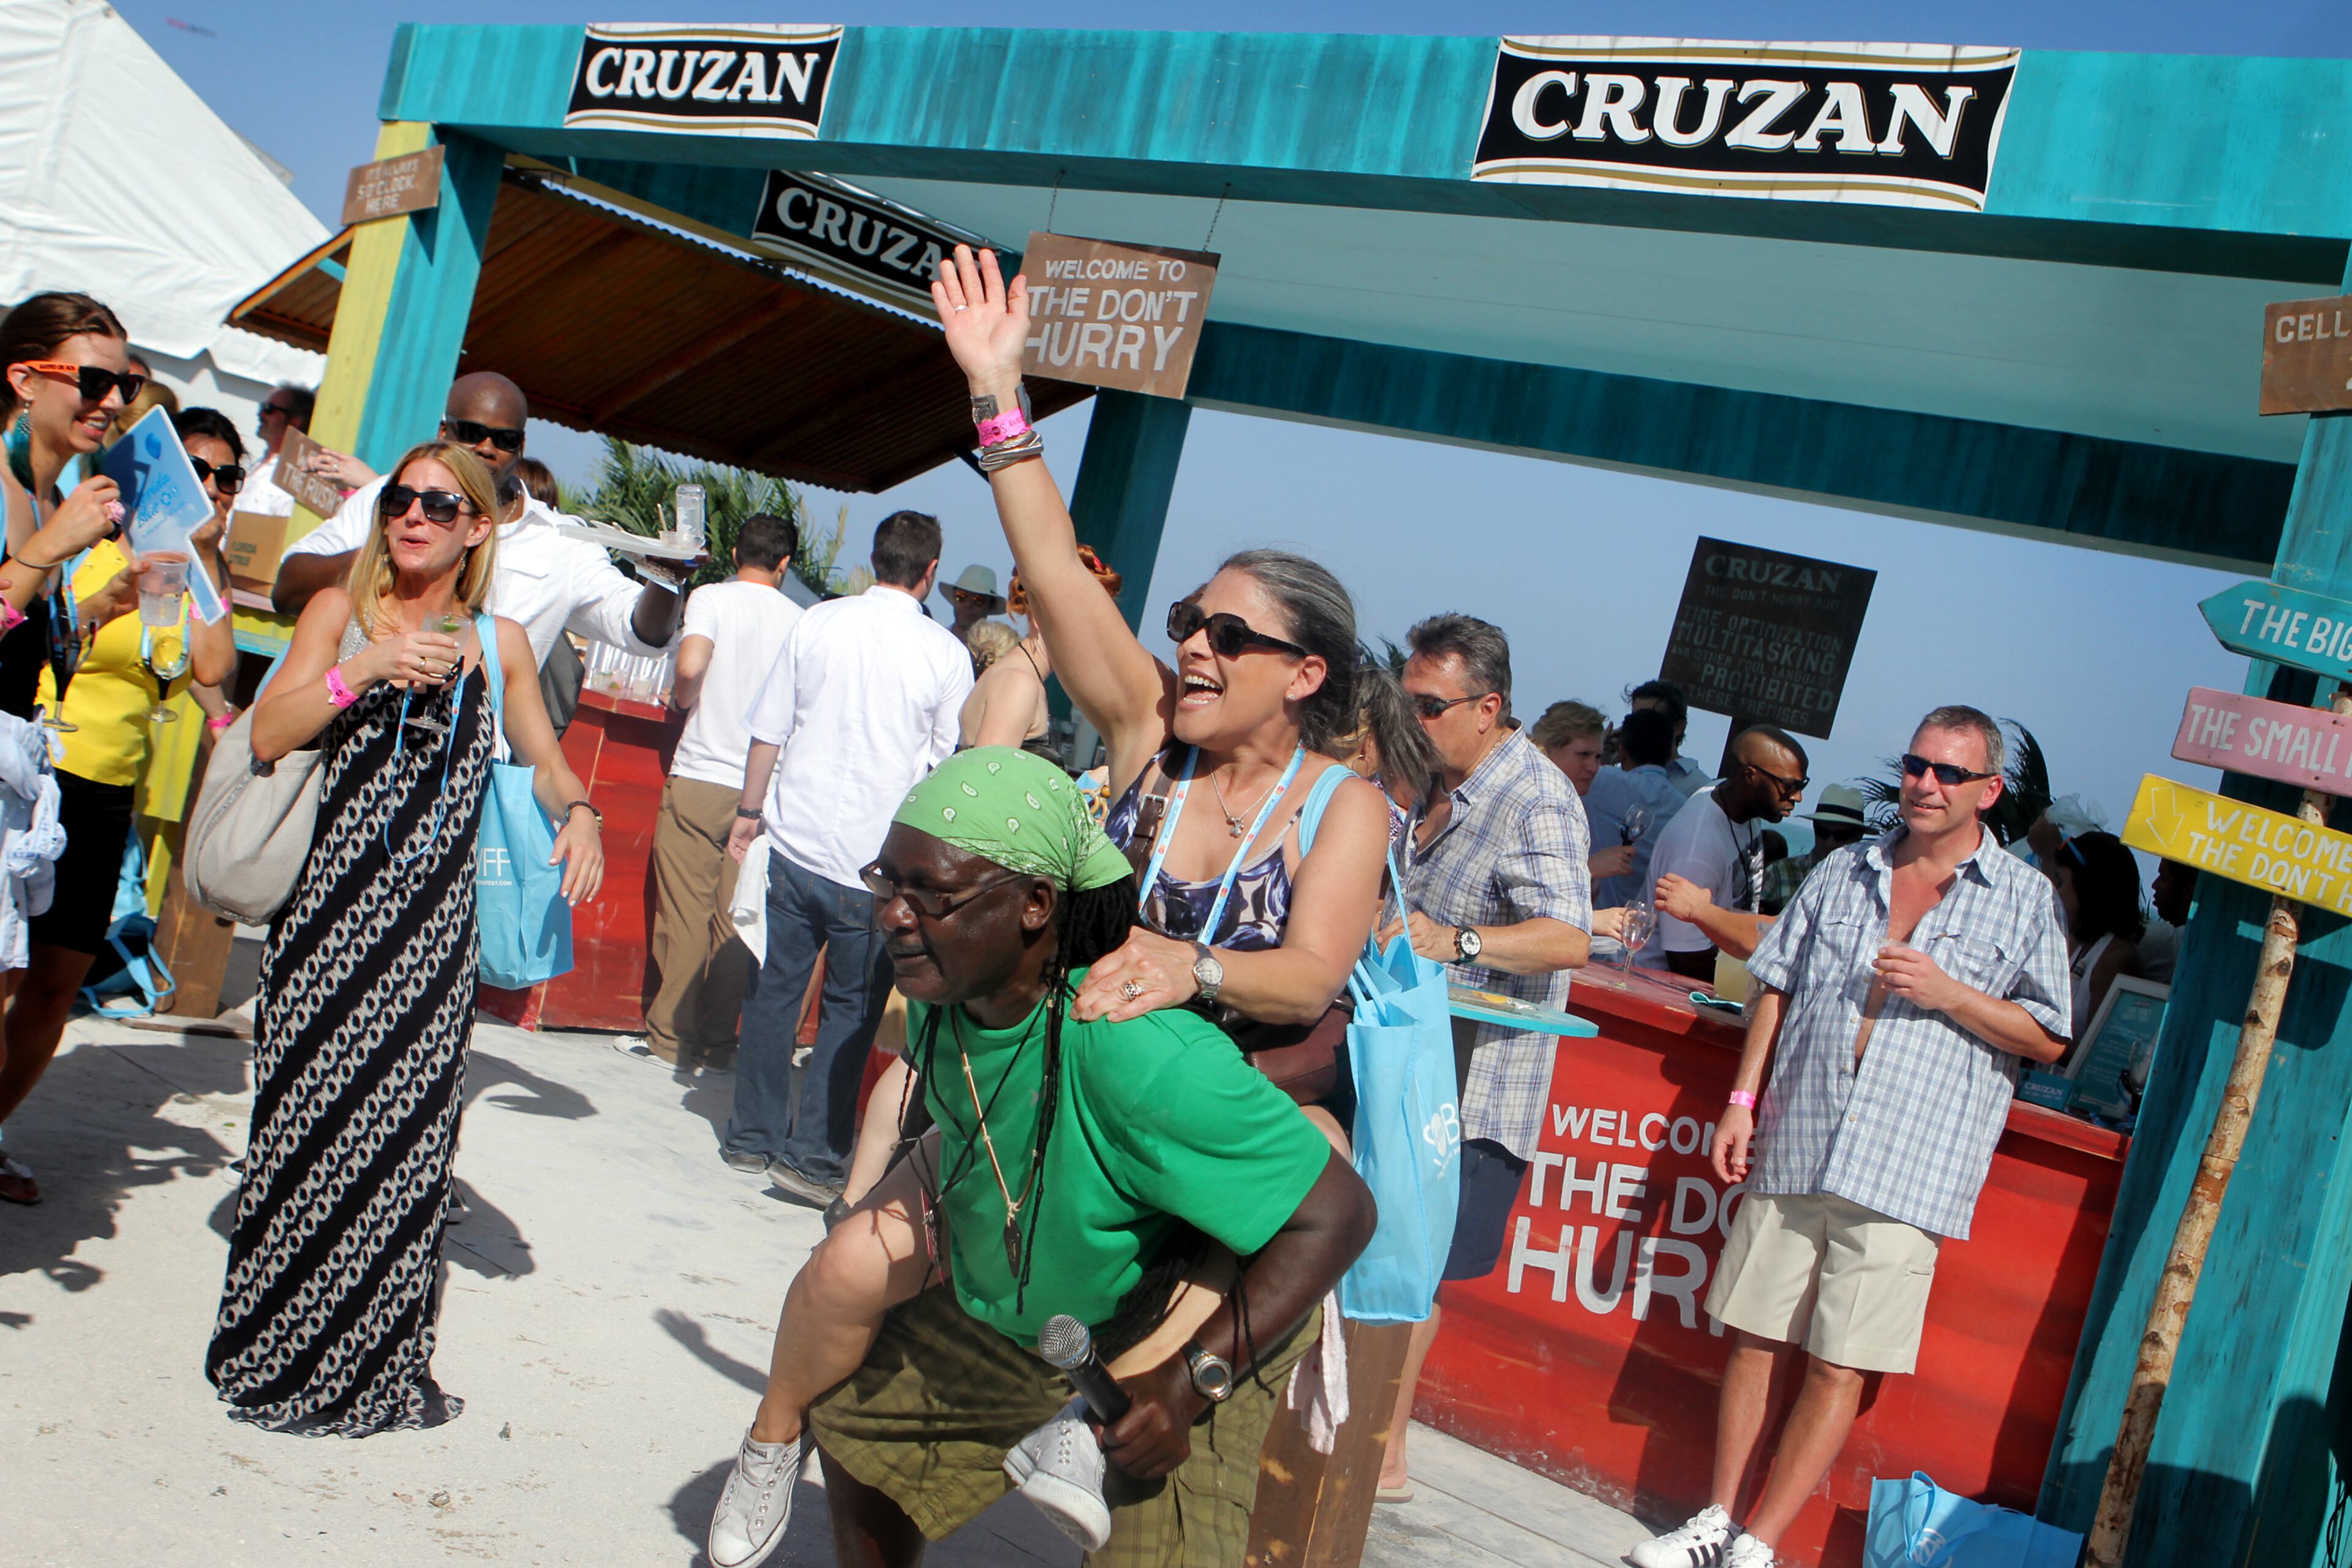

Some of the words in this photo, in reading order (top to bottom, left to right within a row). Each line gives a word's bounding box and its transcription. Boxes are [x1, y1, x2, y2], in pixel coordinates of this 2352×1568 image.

[586, 47, 821, 104] CRUZAN
[1512, 70, 1977, 159] CRUZAN
[365, 194, 400, 214] HERE
[776, 187, 981, 282] CRUZA
[1045, 258, 1148, 281] WELCOME
[1157, 260, 1186, 282] TO
[1027, 285, 1090, 317] THE
[1097, 288, 1197, 322] DON'T
[2275, 311, 2351, 343] CELL
[1025, 322, 1184, 371] HURRY
[1705, 554, 1842, 593] CRUZAN
[1675, 621, 1837, 676] MULTITASKING
[1683, 604, 1722, 627] TIME
[1728, 616, 1844, 654] OPTIMIZATION
[2239, 598, 2309, 649] THE
[2305, 616, 2352, 662] BIG
[1687, 684, 1732, 706] THESE
[1701, 663, 1834, 713] PROHIBITED
[2187, 704, 2242, 751] THE
[2244, 717, 2340, 774] SMALL
[2207, 800, 2352, 874] WELCOME
[2187, 831, 2244, 873] THE
[2248, 852, 2335, 900] DON'T
[2024, 1082, 2064, 1096] CRUZAN
[1553, 1104, 1756, 1164] WELCO
[1529, 1151, 1649, 1223] THE
[1507, 1216, 1726, 1338] HUR
